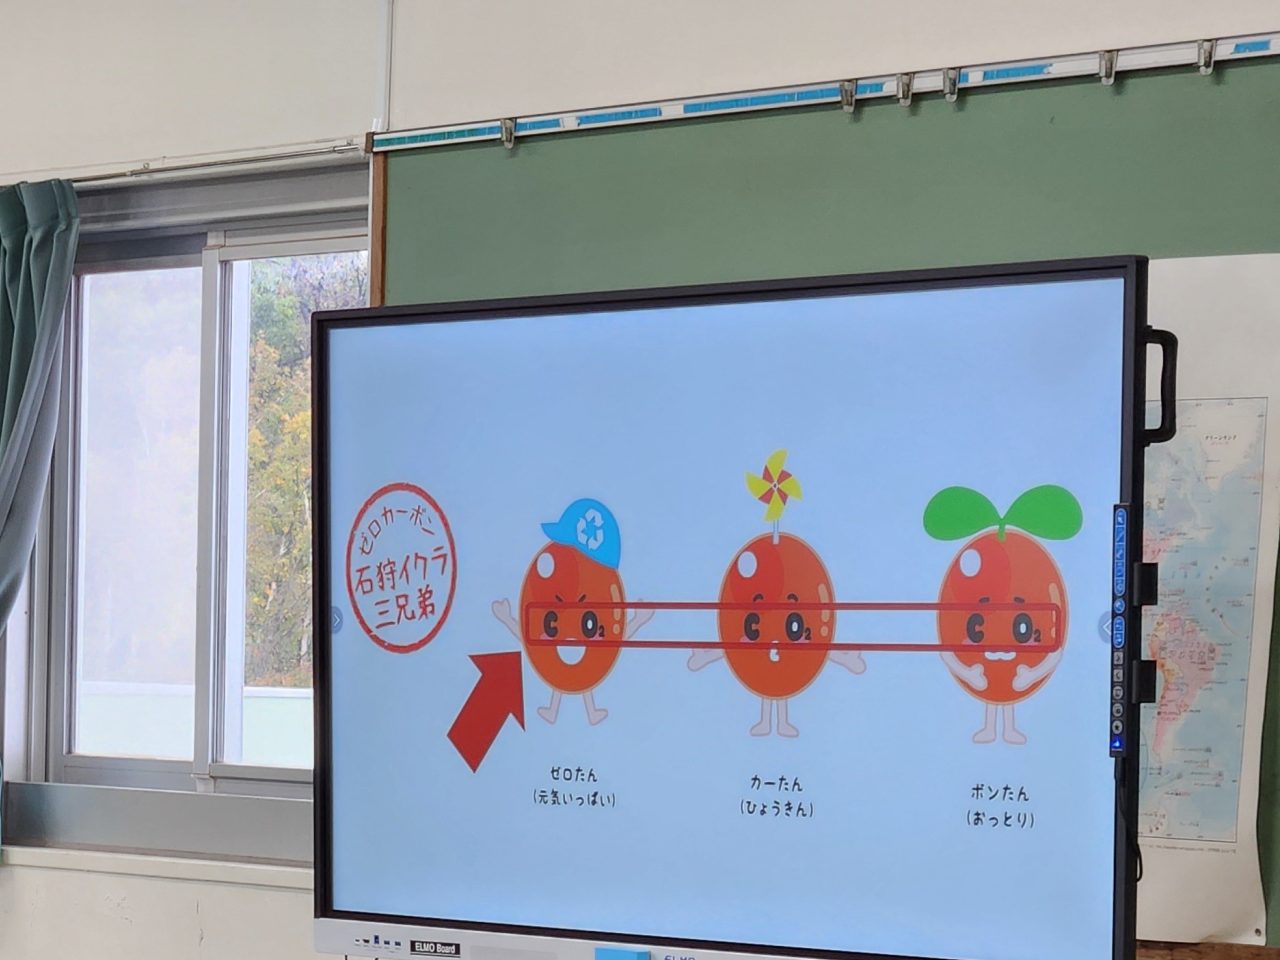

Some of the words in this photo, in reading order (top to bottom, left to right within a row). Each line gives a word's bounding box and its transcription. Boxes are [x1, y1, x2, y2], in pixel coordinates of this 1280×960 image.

[355, 545, 448, 595] 石狩イクラ
[374, 583, 436, 629] 三兄弟
[550, 765, 598, 783] ゼロたん
[751, 774, 803, 793] カーたん
[740, 799, 814, 818] (ひょうきん)
[966, 809, 1035, 829] (おっとり)
[415, 942, 435, 953] ELMO
[436, 943, 456, 954] Board
